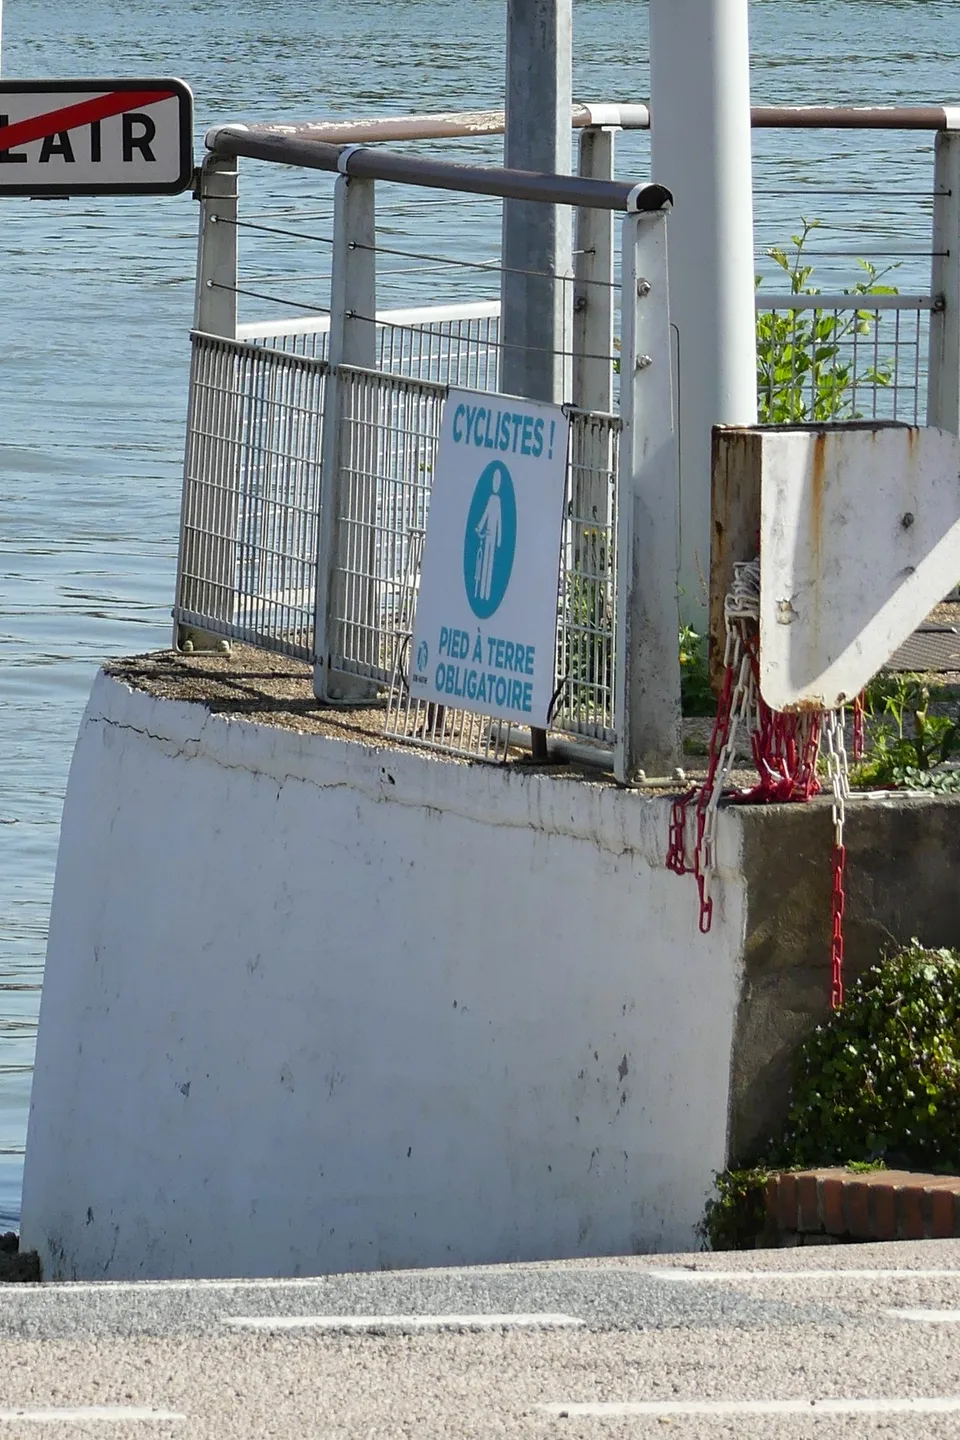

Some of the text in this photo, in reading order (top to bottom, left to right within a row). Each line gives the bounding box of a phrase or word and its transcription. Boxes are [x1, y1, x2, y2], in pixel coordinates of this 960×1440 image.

[452, 403, 556, 460] CYCLISTES !
[438, 626, 536, 676] PIED À TERRE
[435, 662, 533, 713] OBLIGATOIRE
